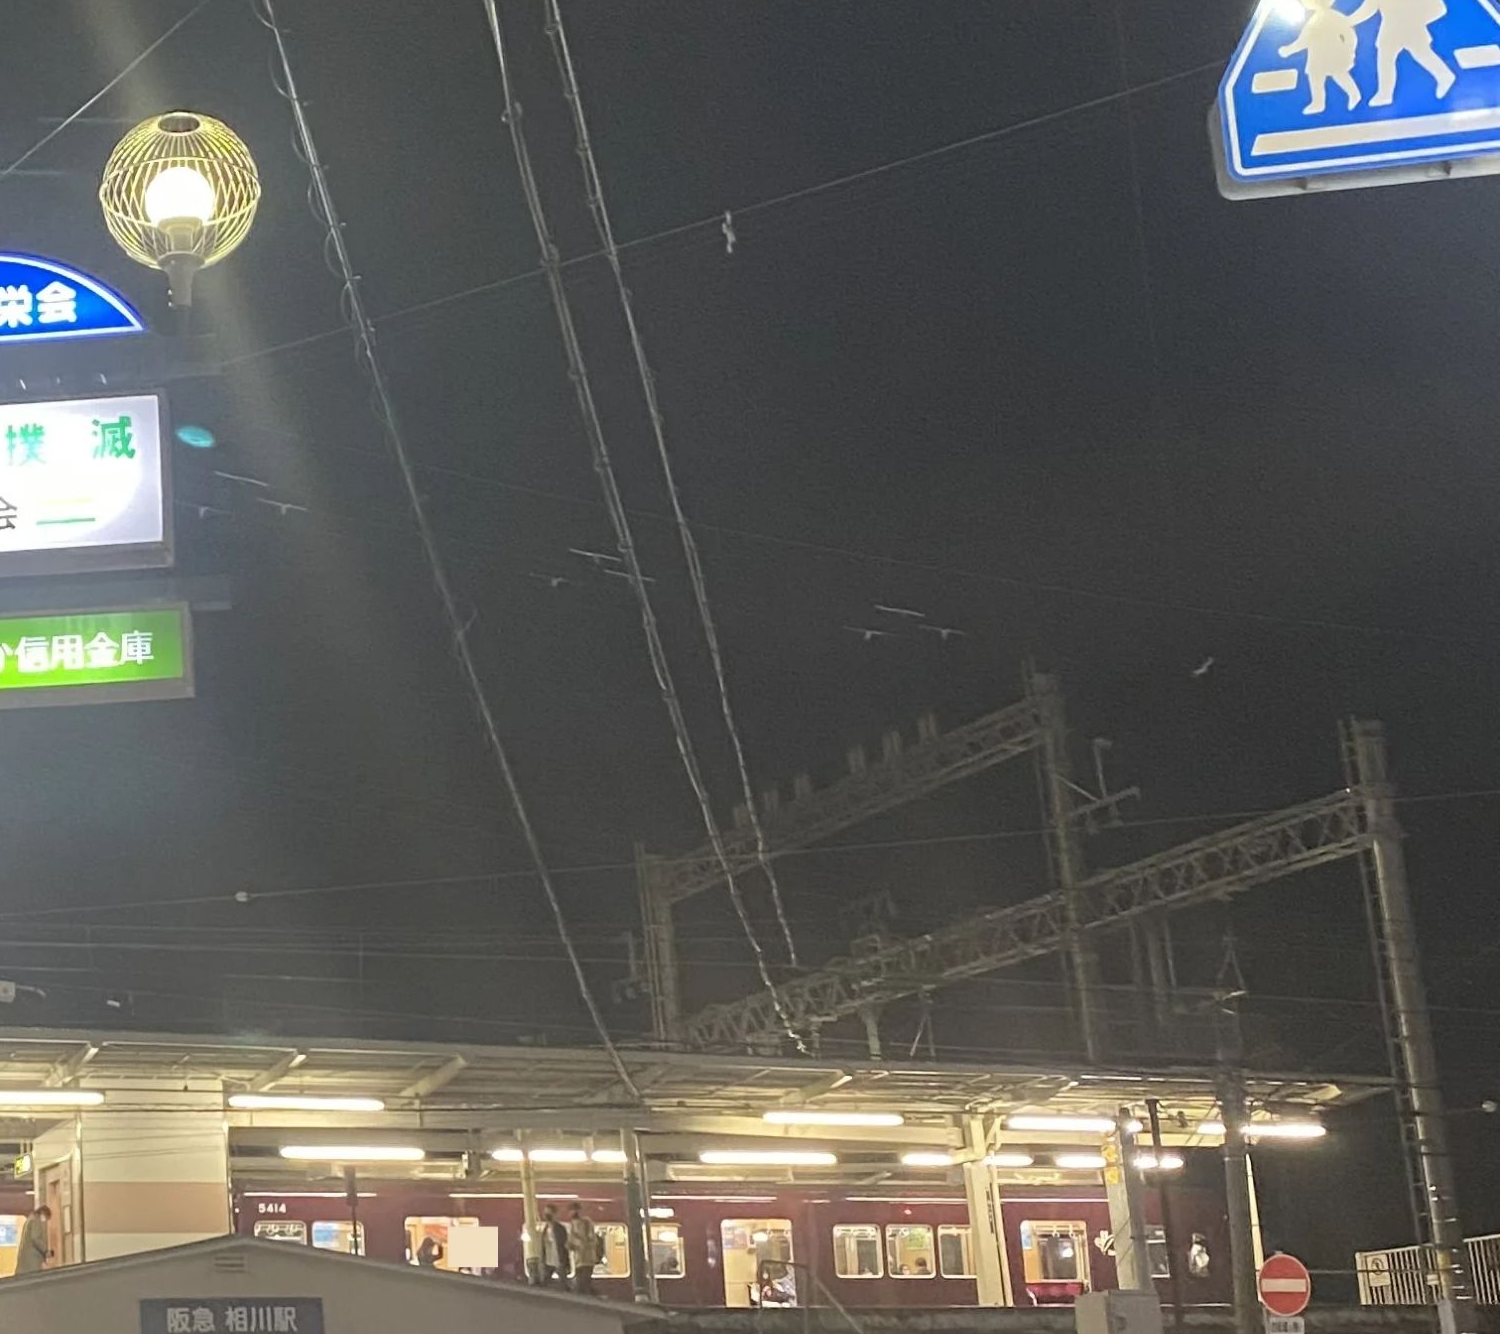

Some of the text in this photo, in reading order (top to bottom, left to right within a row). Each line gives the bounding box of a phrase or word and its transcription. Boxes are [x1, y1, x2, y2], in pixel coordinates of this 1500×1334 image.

[258, 1203, 287, 1214] 5414
[167, 1306, 298, 1333] 阪急 相川駅
